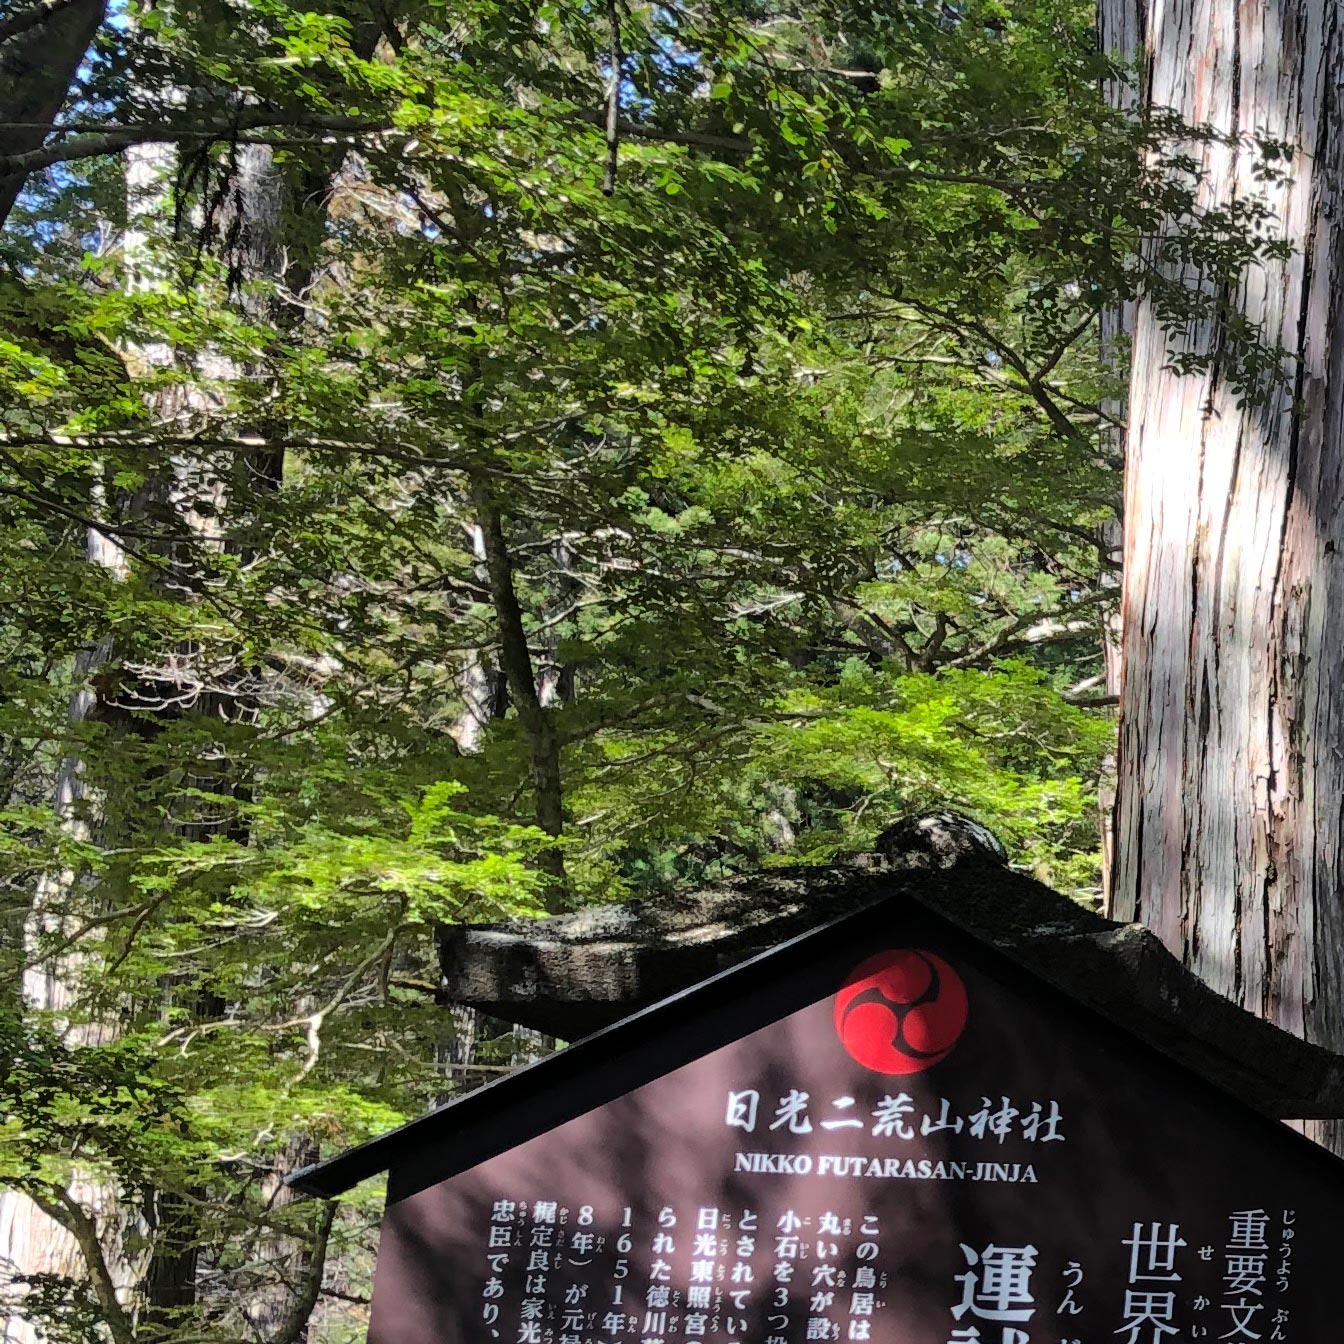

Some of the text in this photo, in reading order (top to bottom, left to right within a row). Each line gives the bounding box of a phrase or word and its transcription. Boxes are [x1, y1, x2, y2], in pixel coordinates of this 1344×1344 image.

[725, 1088, 1066, 1144] 日光二荒山神社
[734, 1152, 1039, 1184] NIKKO FUTARASAN-JINJA
